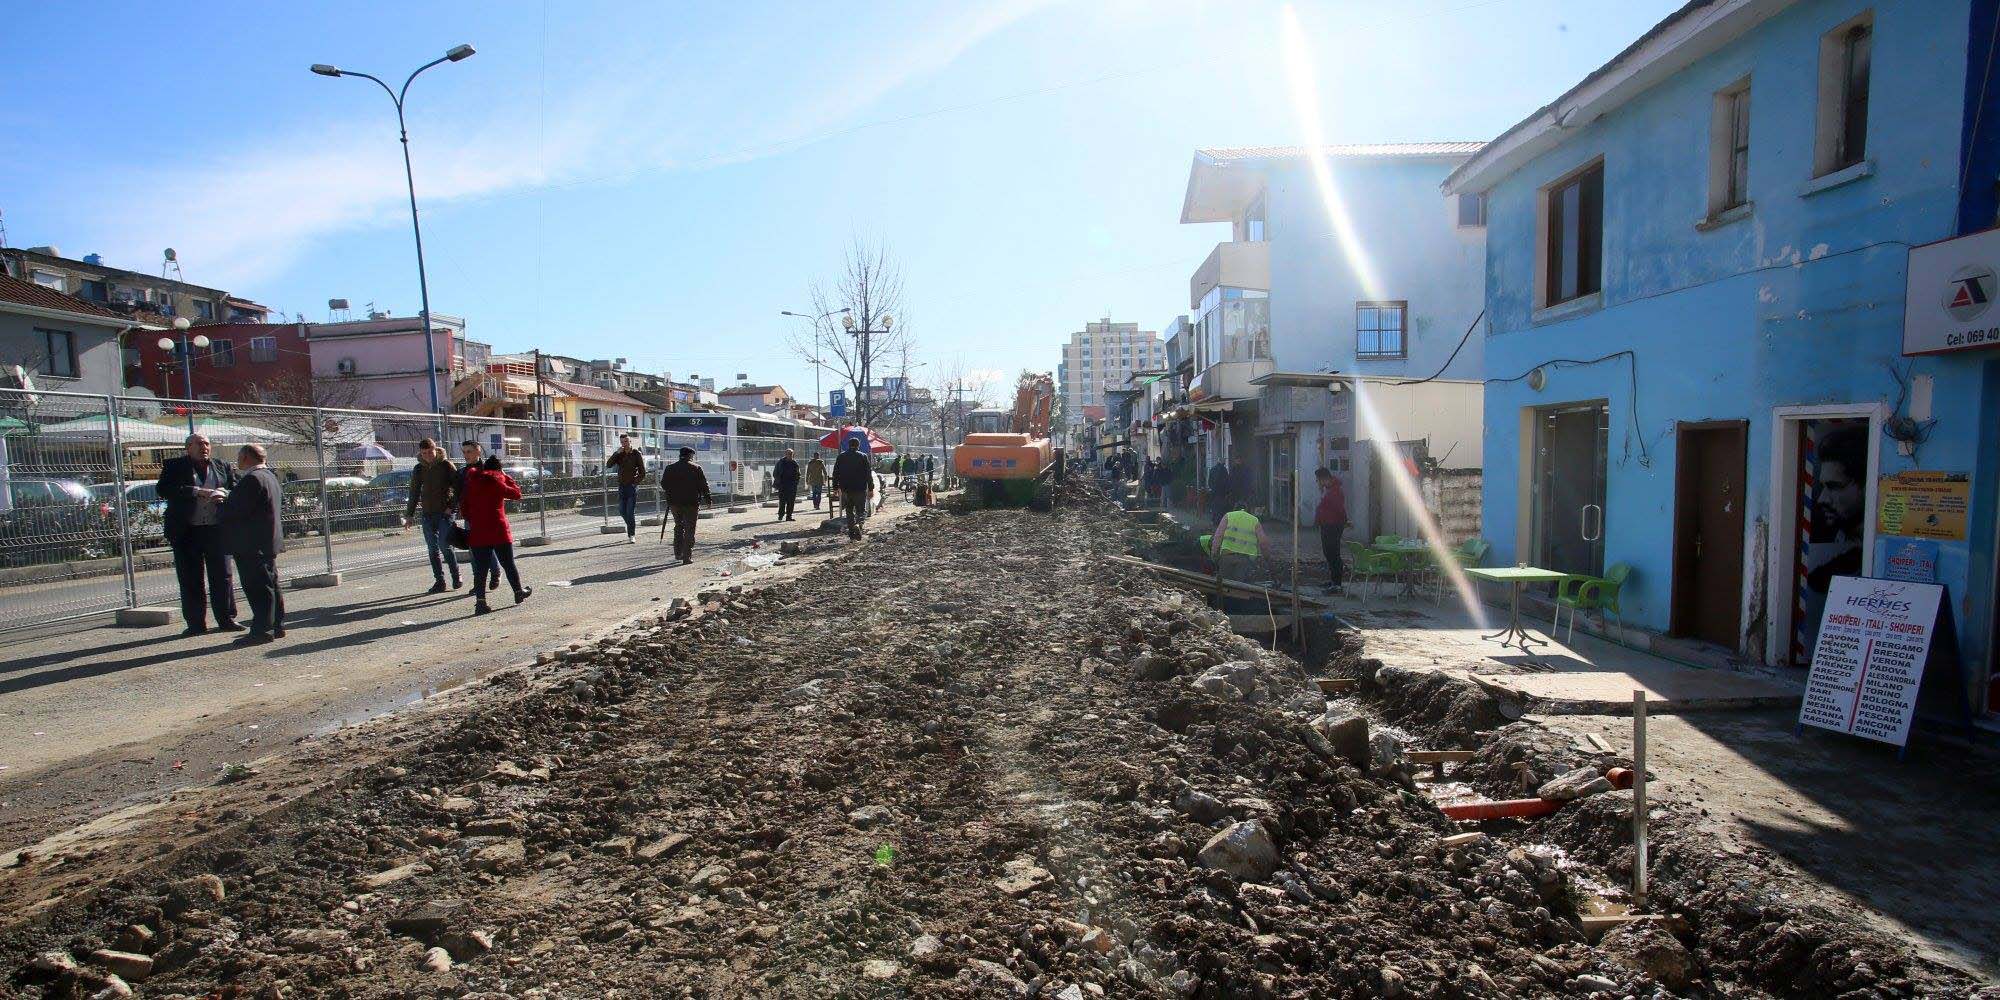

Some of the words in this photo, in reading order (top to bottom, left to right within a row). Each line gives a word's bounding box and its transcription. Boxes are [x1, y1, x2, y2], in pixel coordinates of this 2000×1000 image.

[1947, 333, 1964, 345] Cel:
[1967, 329, 1984, 343] 069
[833, 394, 841, 405] P
[1847, 596, 1912, 612] HERMES
[1828, 614, 1861, 626] SHQIPERI
[1866, 619, 1884, 629] ITALI
[1889, 622, 1925, 635] SHQIPERI
[1822, 633, 1860, 643] SAVONA
[1821, 640, 1858, 650] GENOVA
[1875, 641, 1923, 653] BERGAMO
[1819, 647, 1846, 655] PISSA
[1874, 649, 1915, 660] BRESCIA
[1818, 654, 1858, 664] PERUGIA
[1872, 657, 1912, 668] VERONA
[1816, 660, 1856, 671] FIRENZE
[1870, 664, 1907, 675] PADOVA
[1814, 667, 1851, 677] AREZZO
[1813, 674, 1839, 682] ROME
[1868, 672, 1916, 685] ALESSANDRIA
[1866, 680, 1903, 691] MILANO
[1810, 687, 1831, 696] BARI
[1865, 687, 1901, 699] TORINO
[1808, 694, 1836, 704] SICILI
[1862, 695, 1908, 709] BOLOGNA
[1807, 701, 1842, 712] MESINA
[1860, 703, 1901, 716] MODENA
[1805, 708, 1844, 720] CATANIA
[1859, 711, 1902, 725] PESCARA
[1803, 714, 1840, 727] RAGUSA
[1857, 719, 1896, 732] ANCONA
[1855, 726, 1888, 738] SHIKLI
